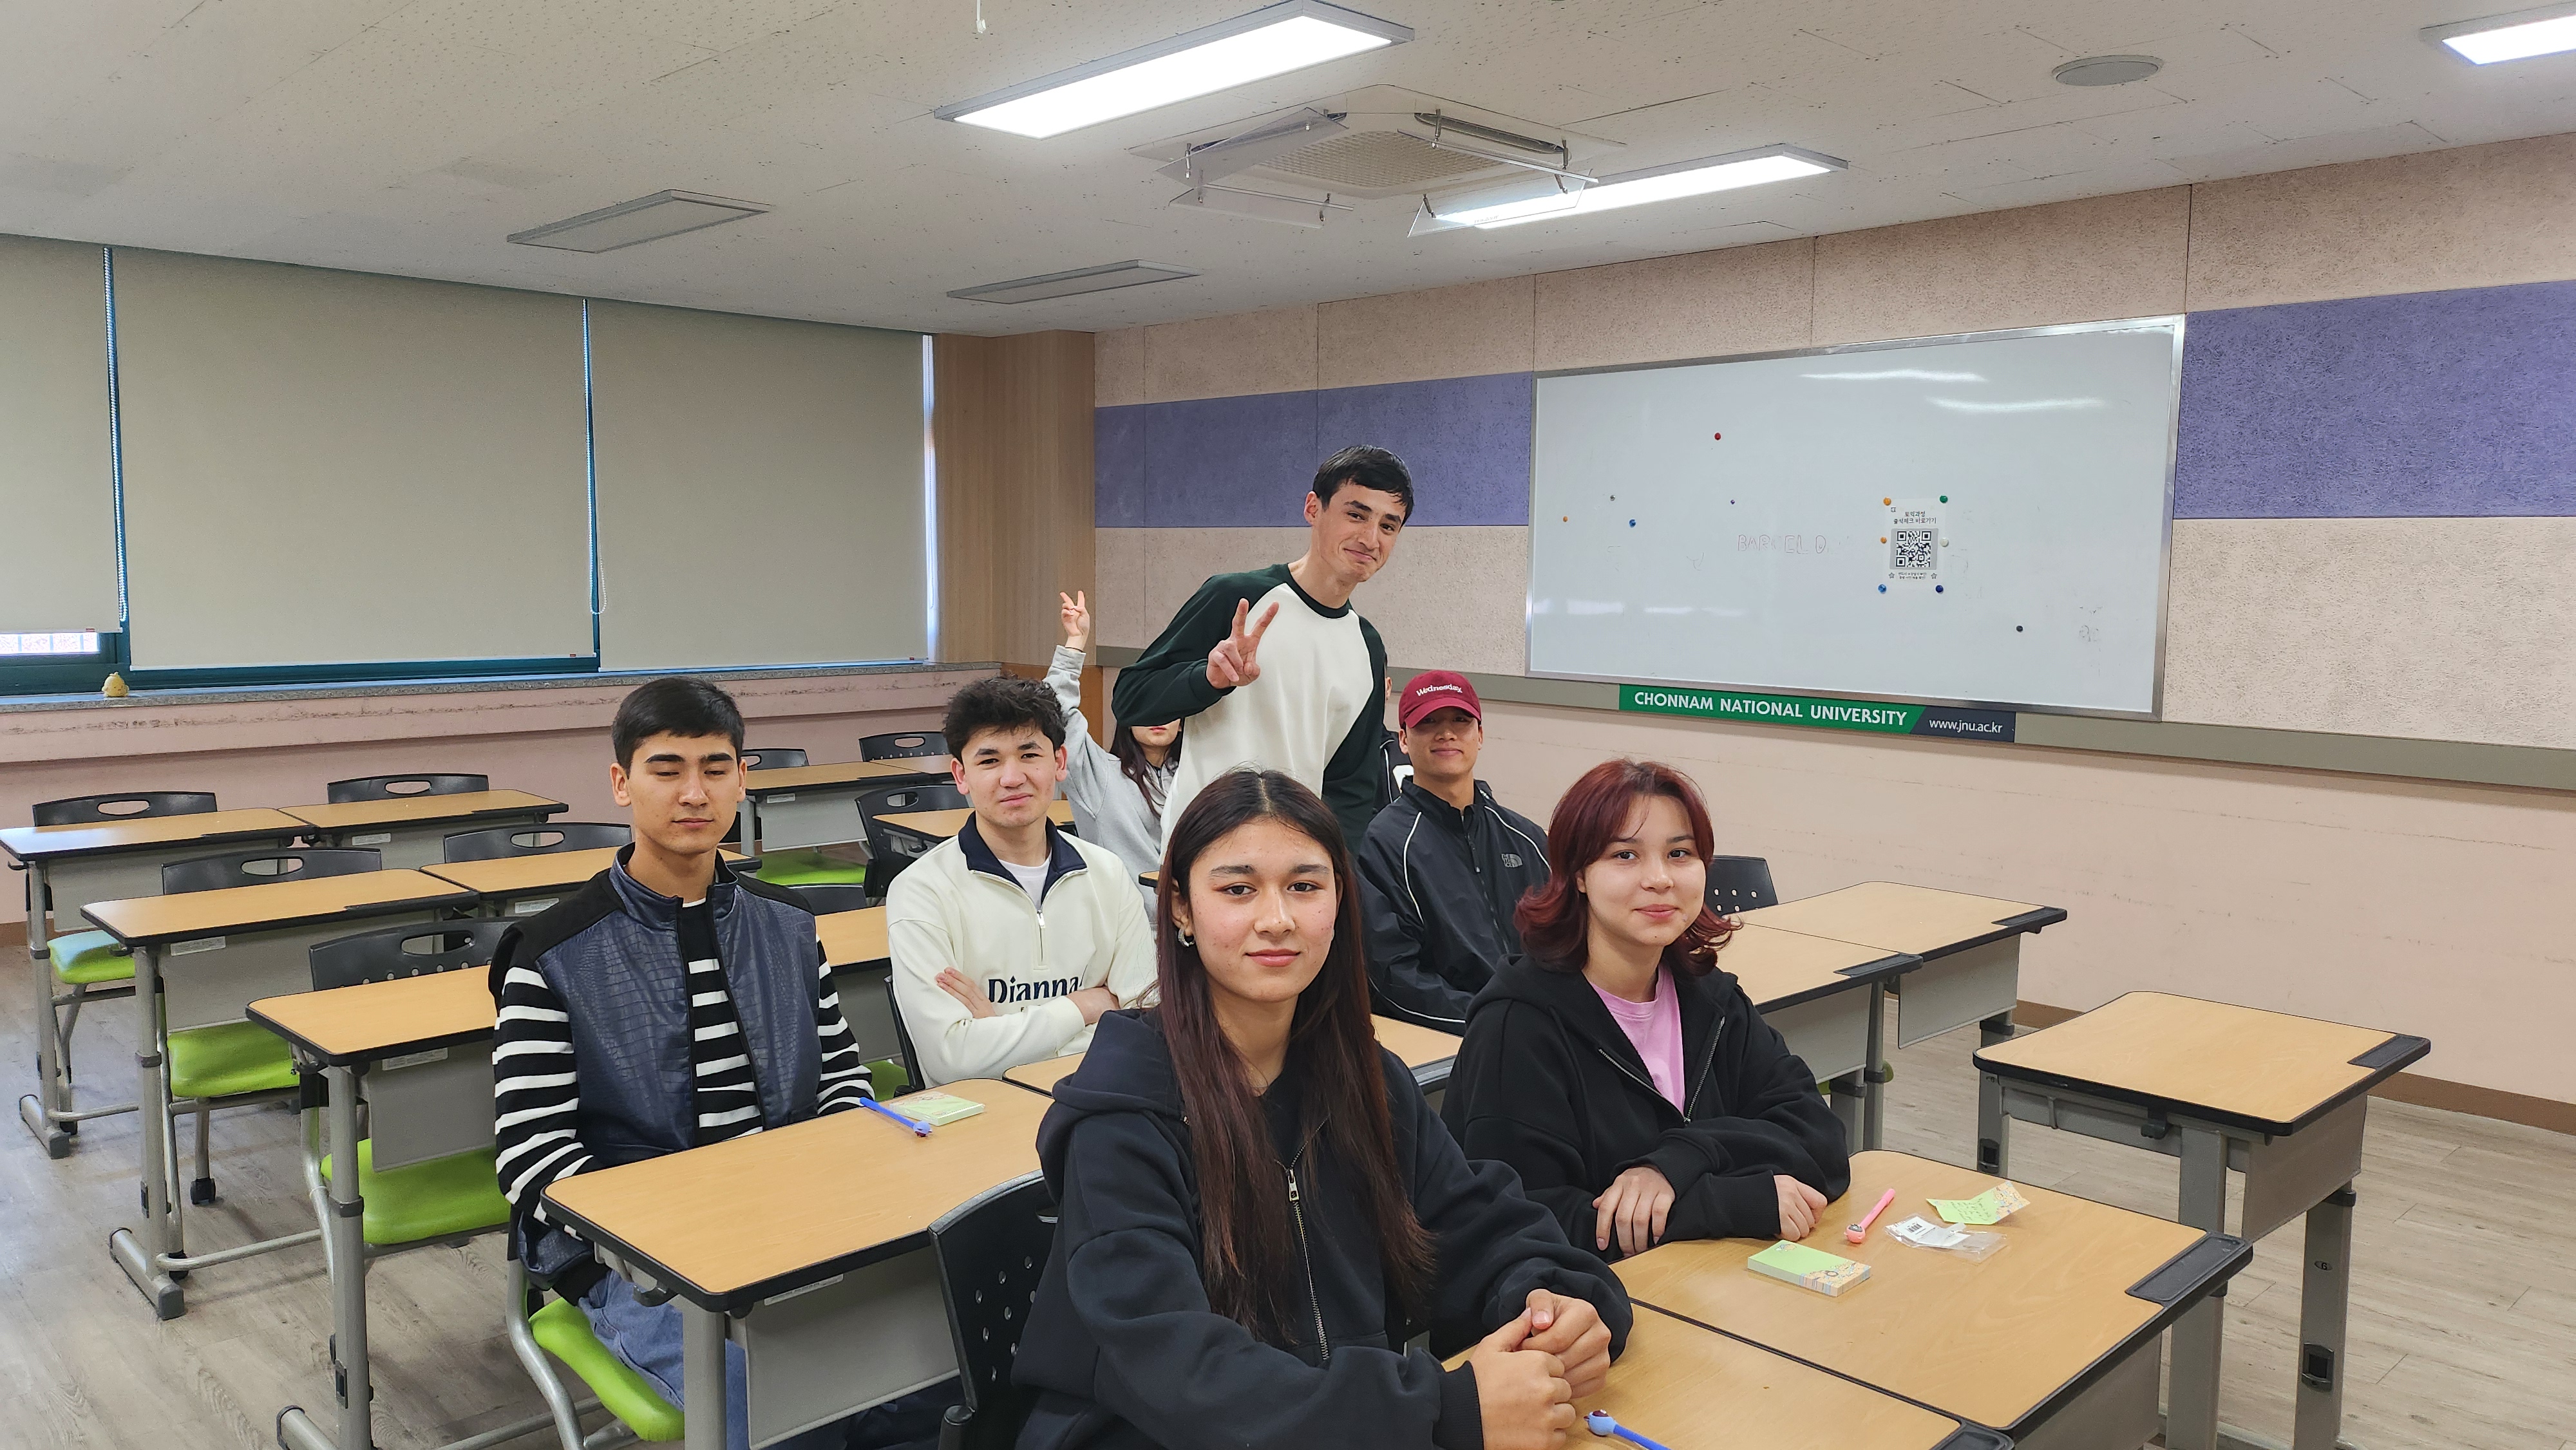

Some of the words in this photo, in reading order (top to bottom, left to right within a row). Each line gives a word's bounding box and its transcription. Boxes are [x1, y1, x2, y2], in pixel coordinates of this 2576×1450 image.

[1634, 692, 1714, 710] CHONNAM
[1720, 698, 1803, 718] NATIONAL
[1810, 704, 1907, 726] UNIVERSITY
[1929, 719, 2003, 733] www.jnu.ac.kr
[989, 975, 1079, 1003] Dianna
